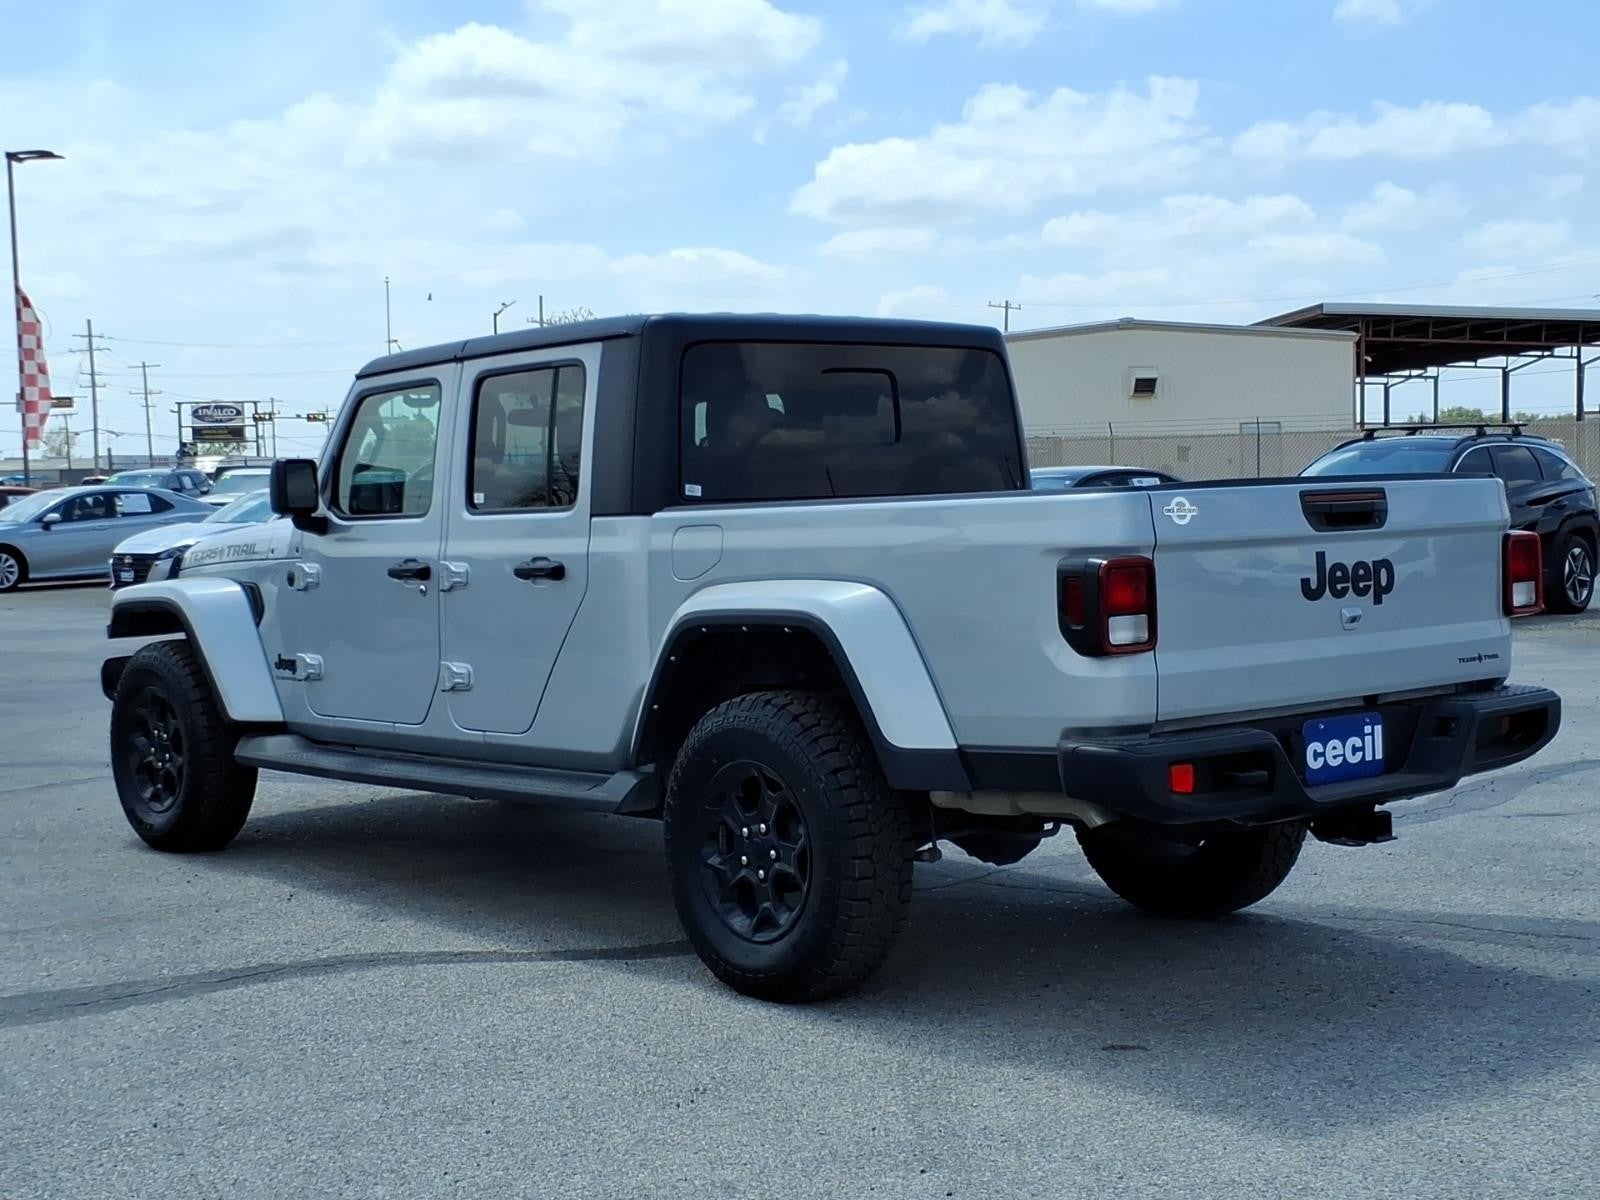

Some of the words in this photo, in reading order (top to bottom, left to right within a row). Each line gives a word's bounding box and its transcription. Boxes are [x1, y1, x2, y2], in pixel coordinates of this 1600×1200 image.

[226, 543, 258, 557] TRAIL
[1300, 550, 1396, 606] Jeep
[274, 652, 298, 676] Jeep
[1306, 724, 1384, 770] cecil
